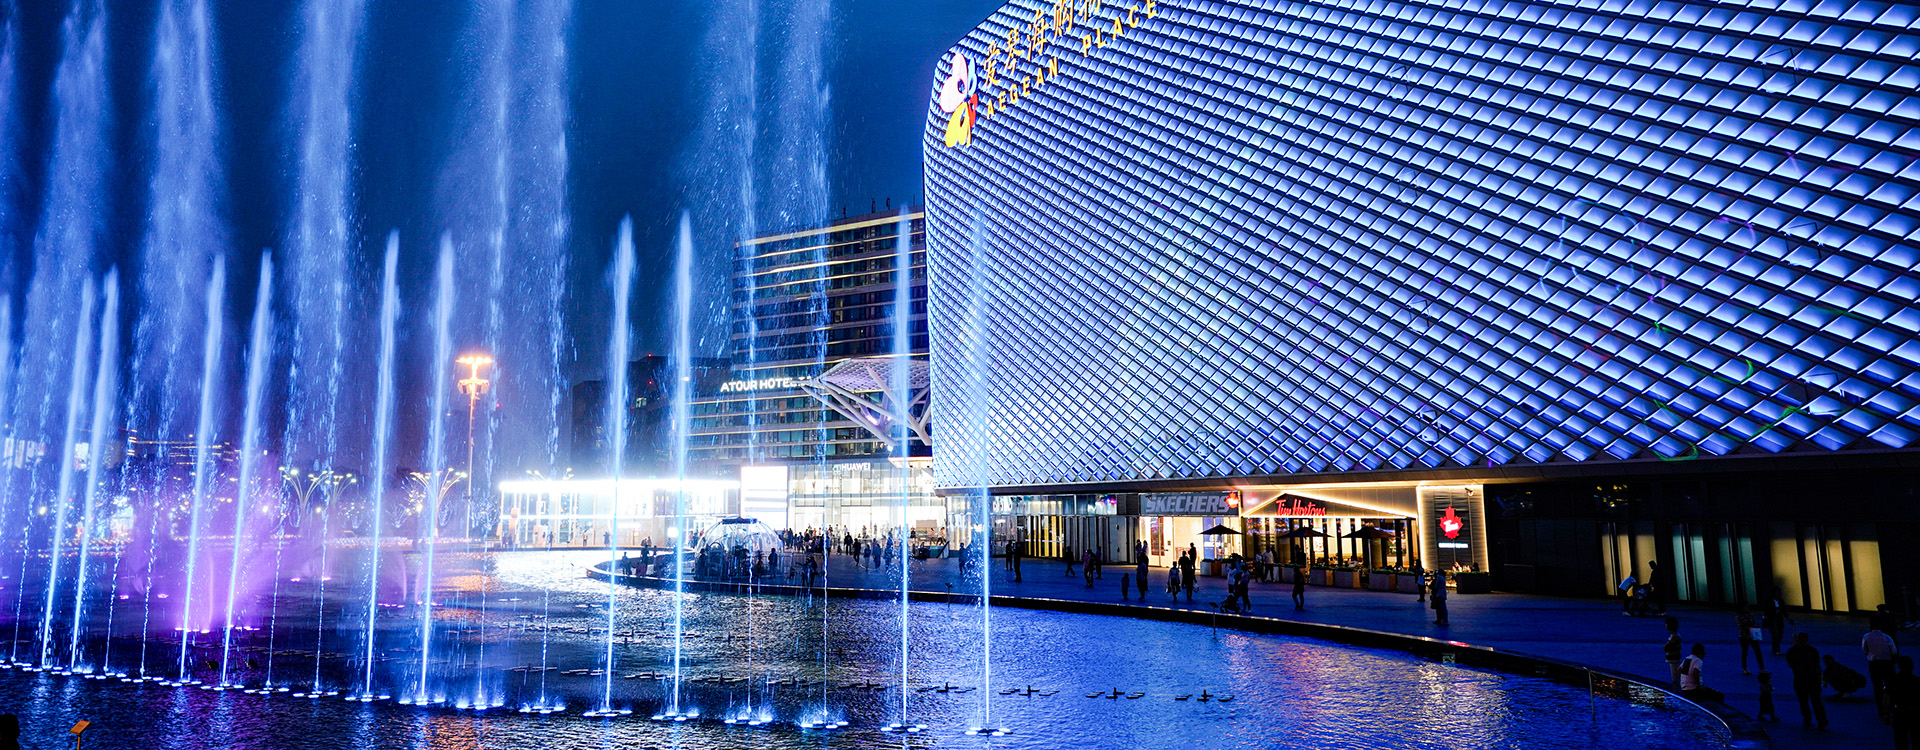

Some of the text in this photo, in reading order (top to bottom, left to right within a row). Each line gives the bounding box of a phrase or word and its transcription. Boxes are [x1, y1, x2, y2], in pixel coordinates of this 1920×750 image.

[986, 0, 1157, 119] AEGEAN PLACE
[720, 379, 757, 393] ATOUR
[841, 462, 871, 471] HUAWEI
[1145, 495, 1231, 513] SKECHERS
[1275, 498, 1326, 516] Tim Hortons
